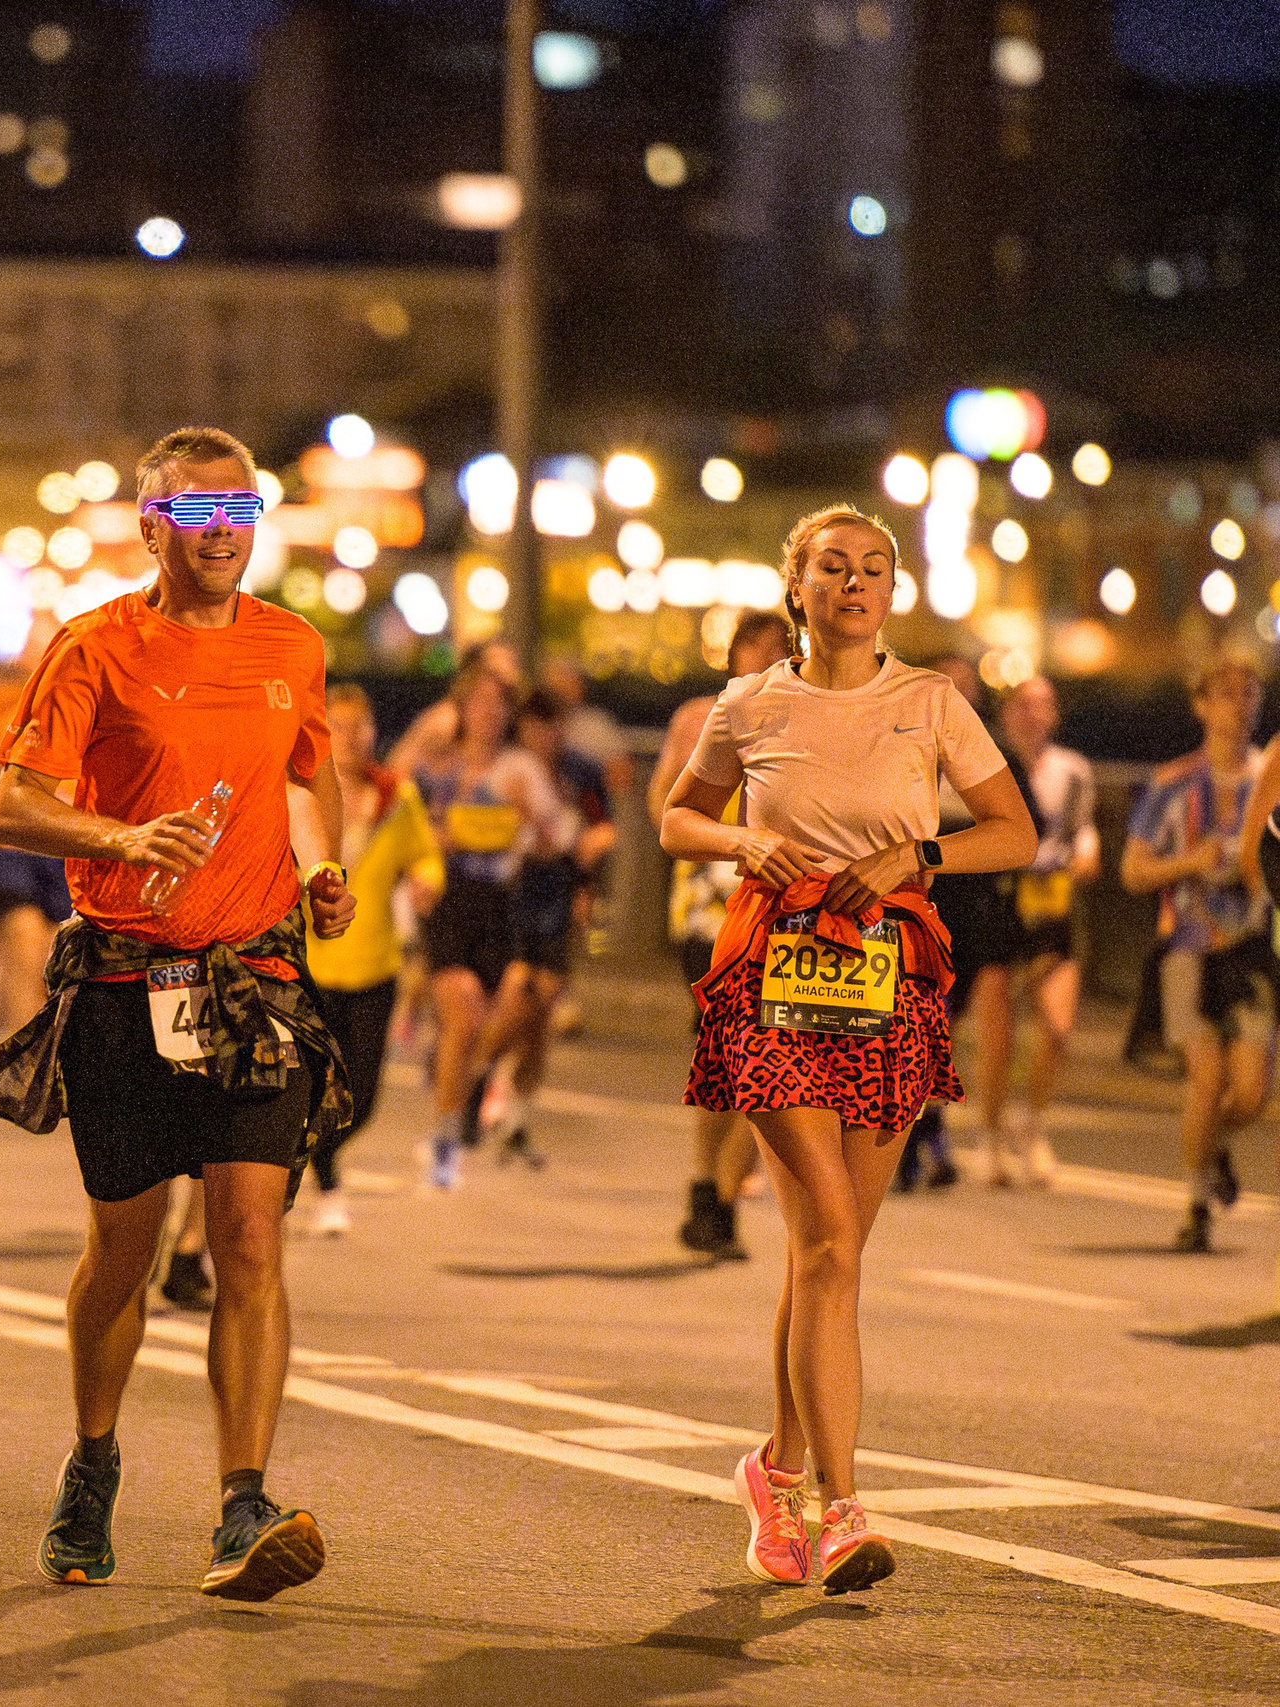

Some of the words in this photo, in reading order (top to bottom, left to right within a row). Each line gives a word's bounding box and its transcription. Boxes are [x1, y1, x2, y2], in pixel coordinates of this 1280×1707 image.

[260, 680, 292, 711] 10
[769, 943, 892, 988] 20329
[793, 984, 865, 1001] АНАСТАСИЯ
[774, 1006, 789, 1026] E
